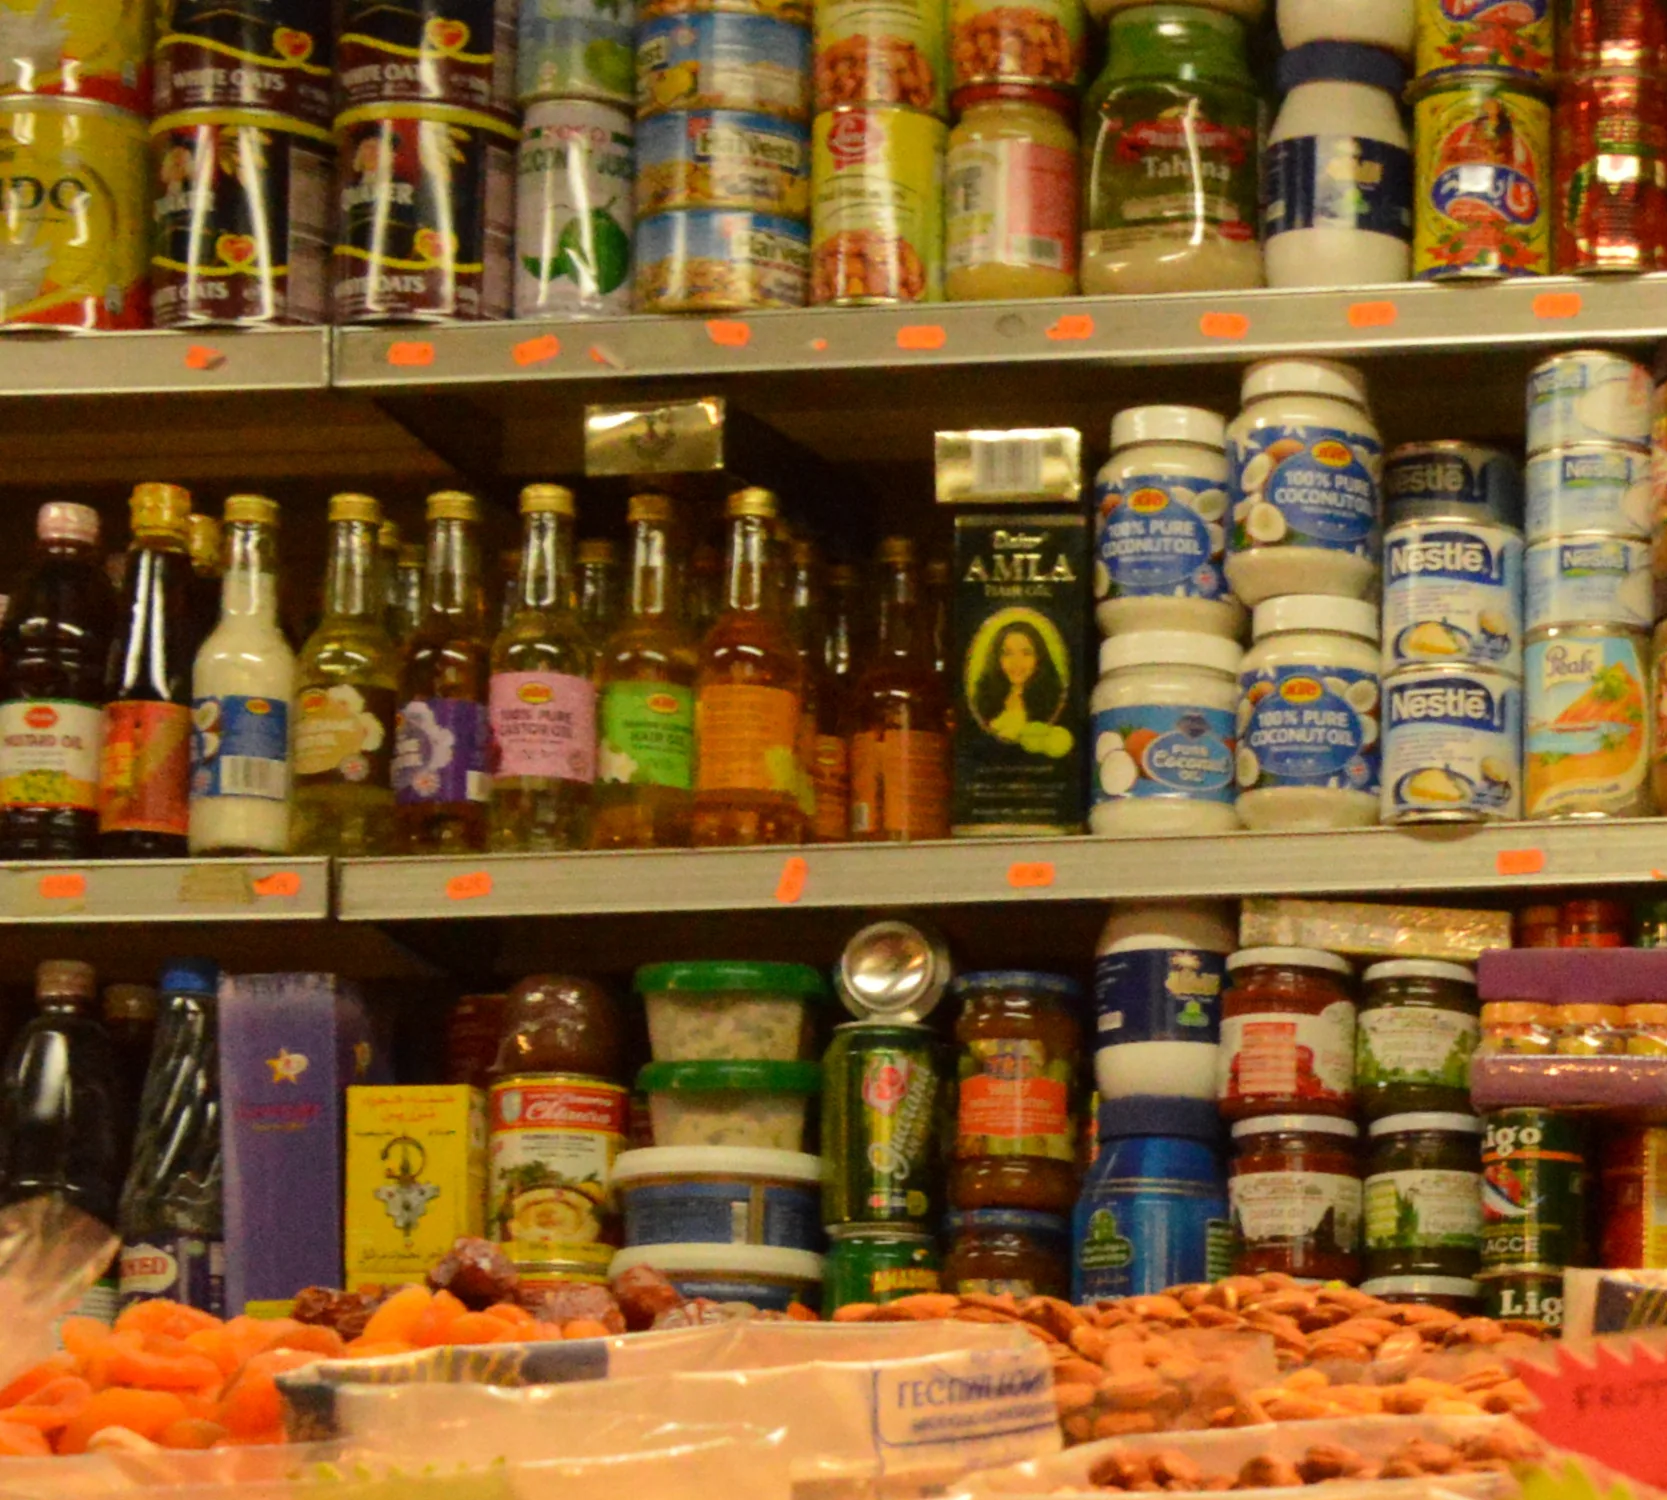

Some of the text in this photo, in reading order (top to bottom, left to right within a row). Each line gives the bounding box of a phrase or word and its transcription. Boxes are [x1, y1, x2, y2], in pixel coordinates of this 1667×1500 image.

[1141, 153, 1231, 183] Tahna
[1149, 519, 1196, 536] PURE
[1303, 710, 1348, 727] PURE
[1481, 1124, 1542, 1157] igo
[1498, 1289, 1565, 1327] Lig
